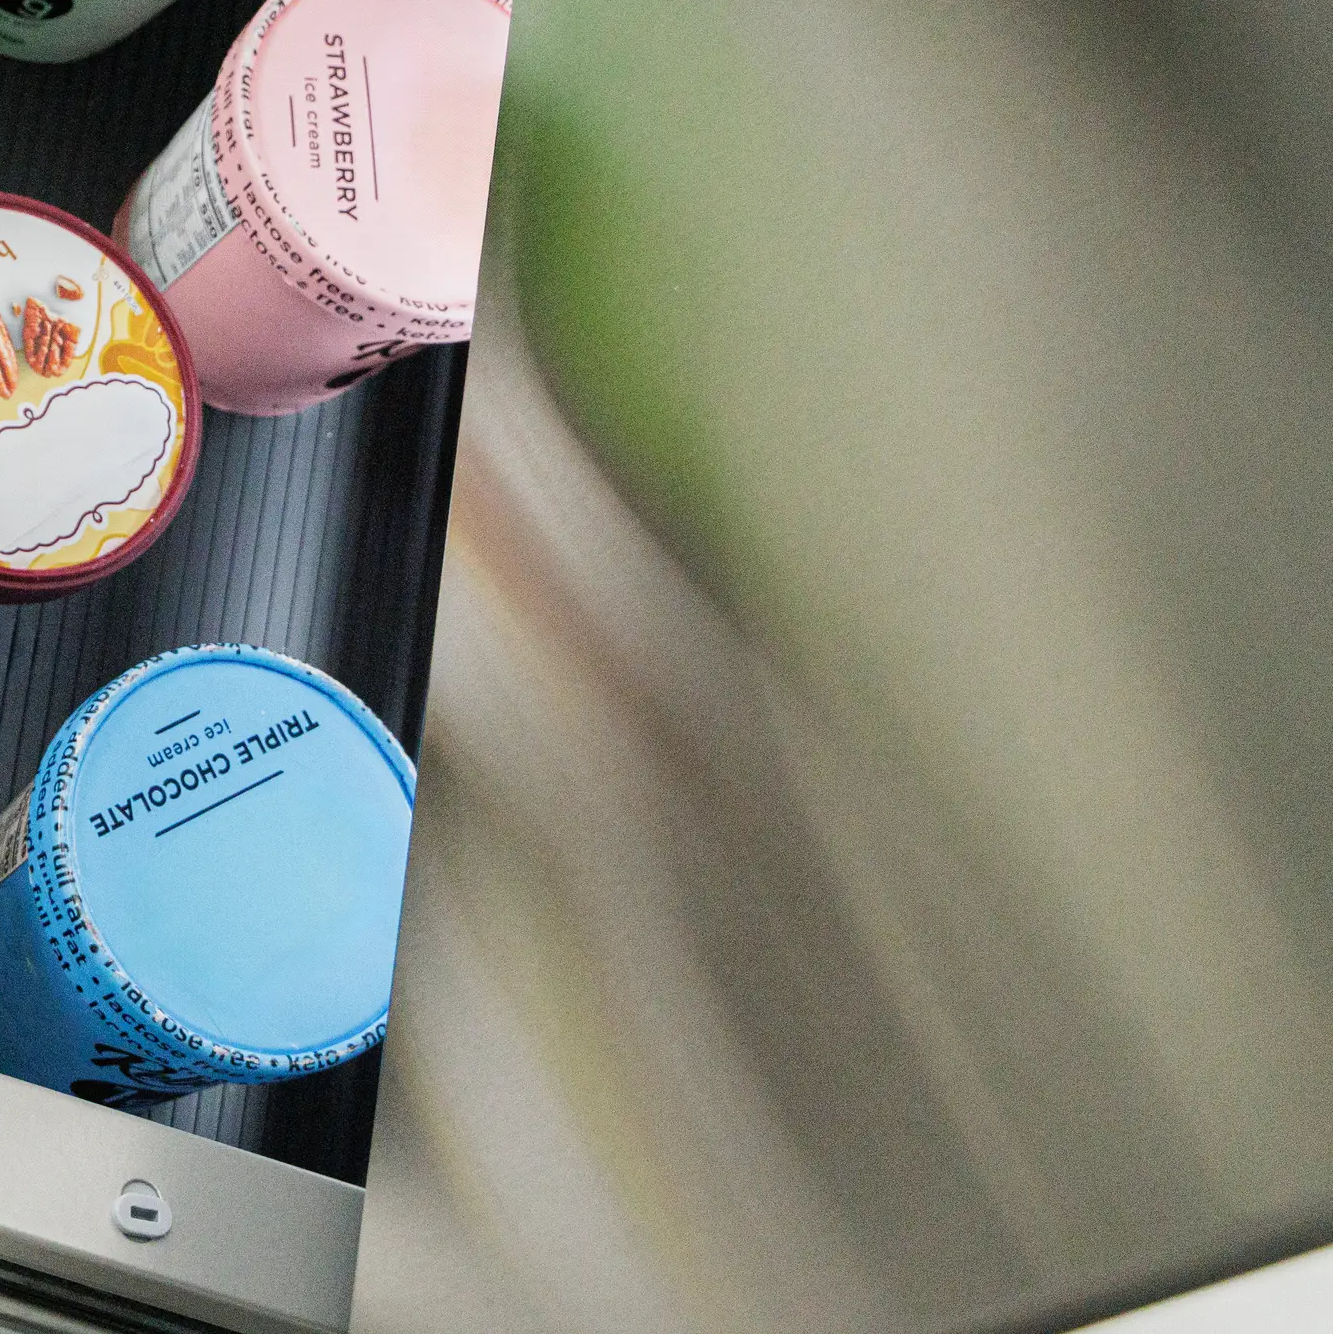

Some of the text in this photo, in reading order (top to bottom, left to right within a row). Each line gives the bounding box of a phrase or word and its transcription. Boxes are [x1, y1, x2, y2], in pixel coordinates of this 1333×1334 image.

[303, 76, 322, 170] ice cream
[323, 33, 360, 223] STRAWBERRY
[241, 181, 304, 265] lactose
[309, 267, 355, 304] free
[88, 709, 320, 838] TRIPLE CHOCOLATE
[147, 717, 231, 769] ice cream
[51, 842, 76, 887] full
[63, 892, 89, 937] fat
